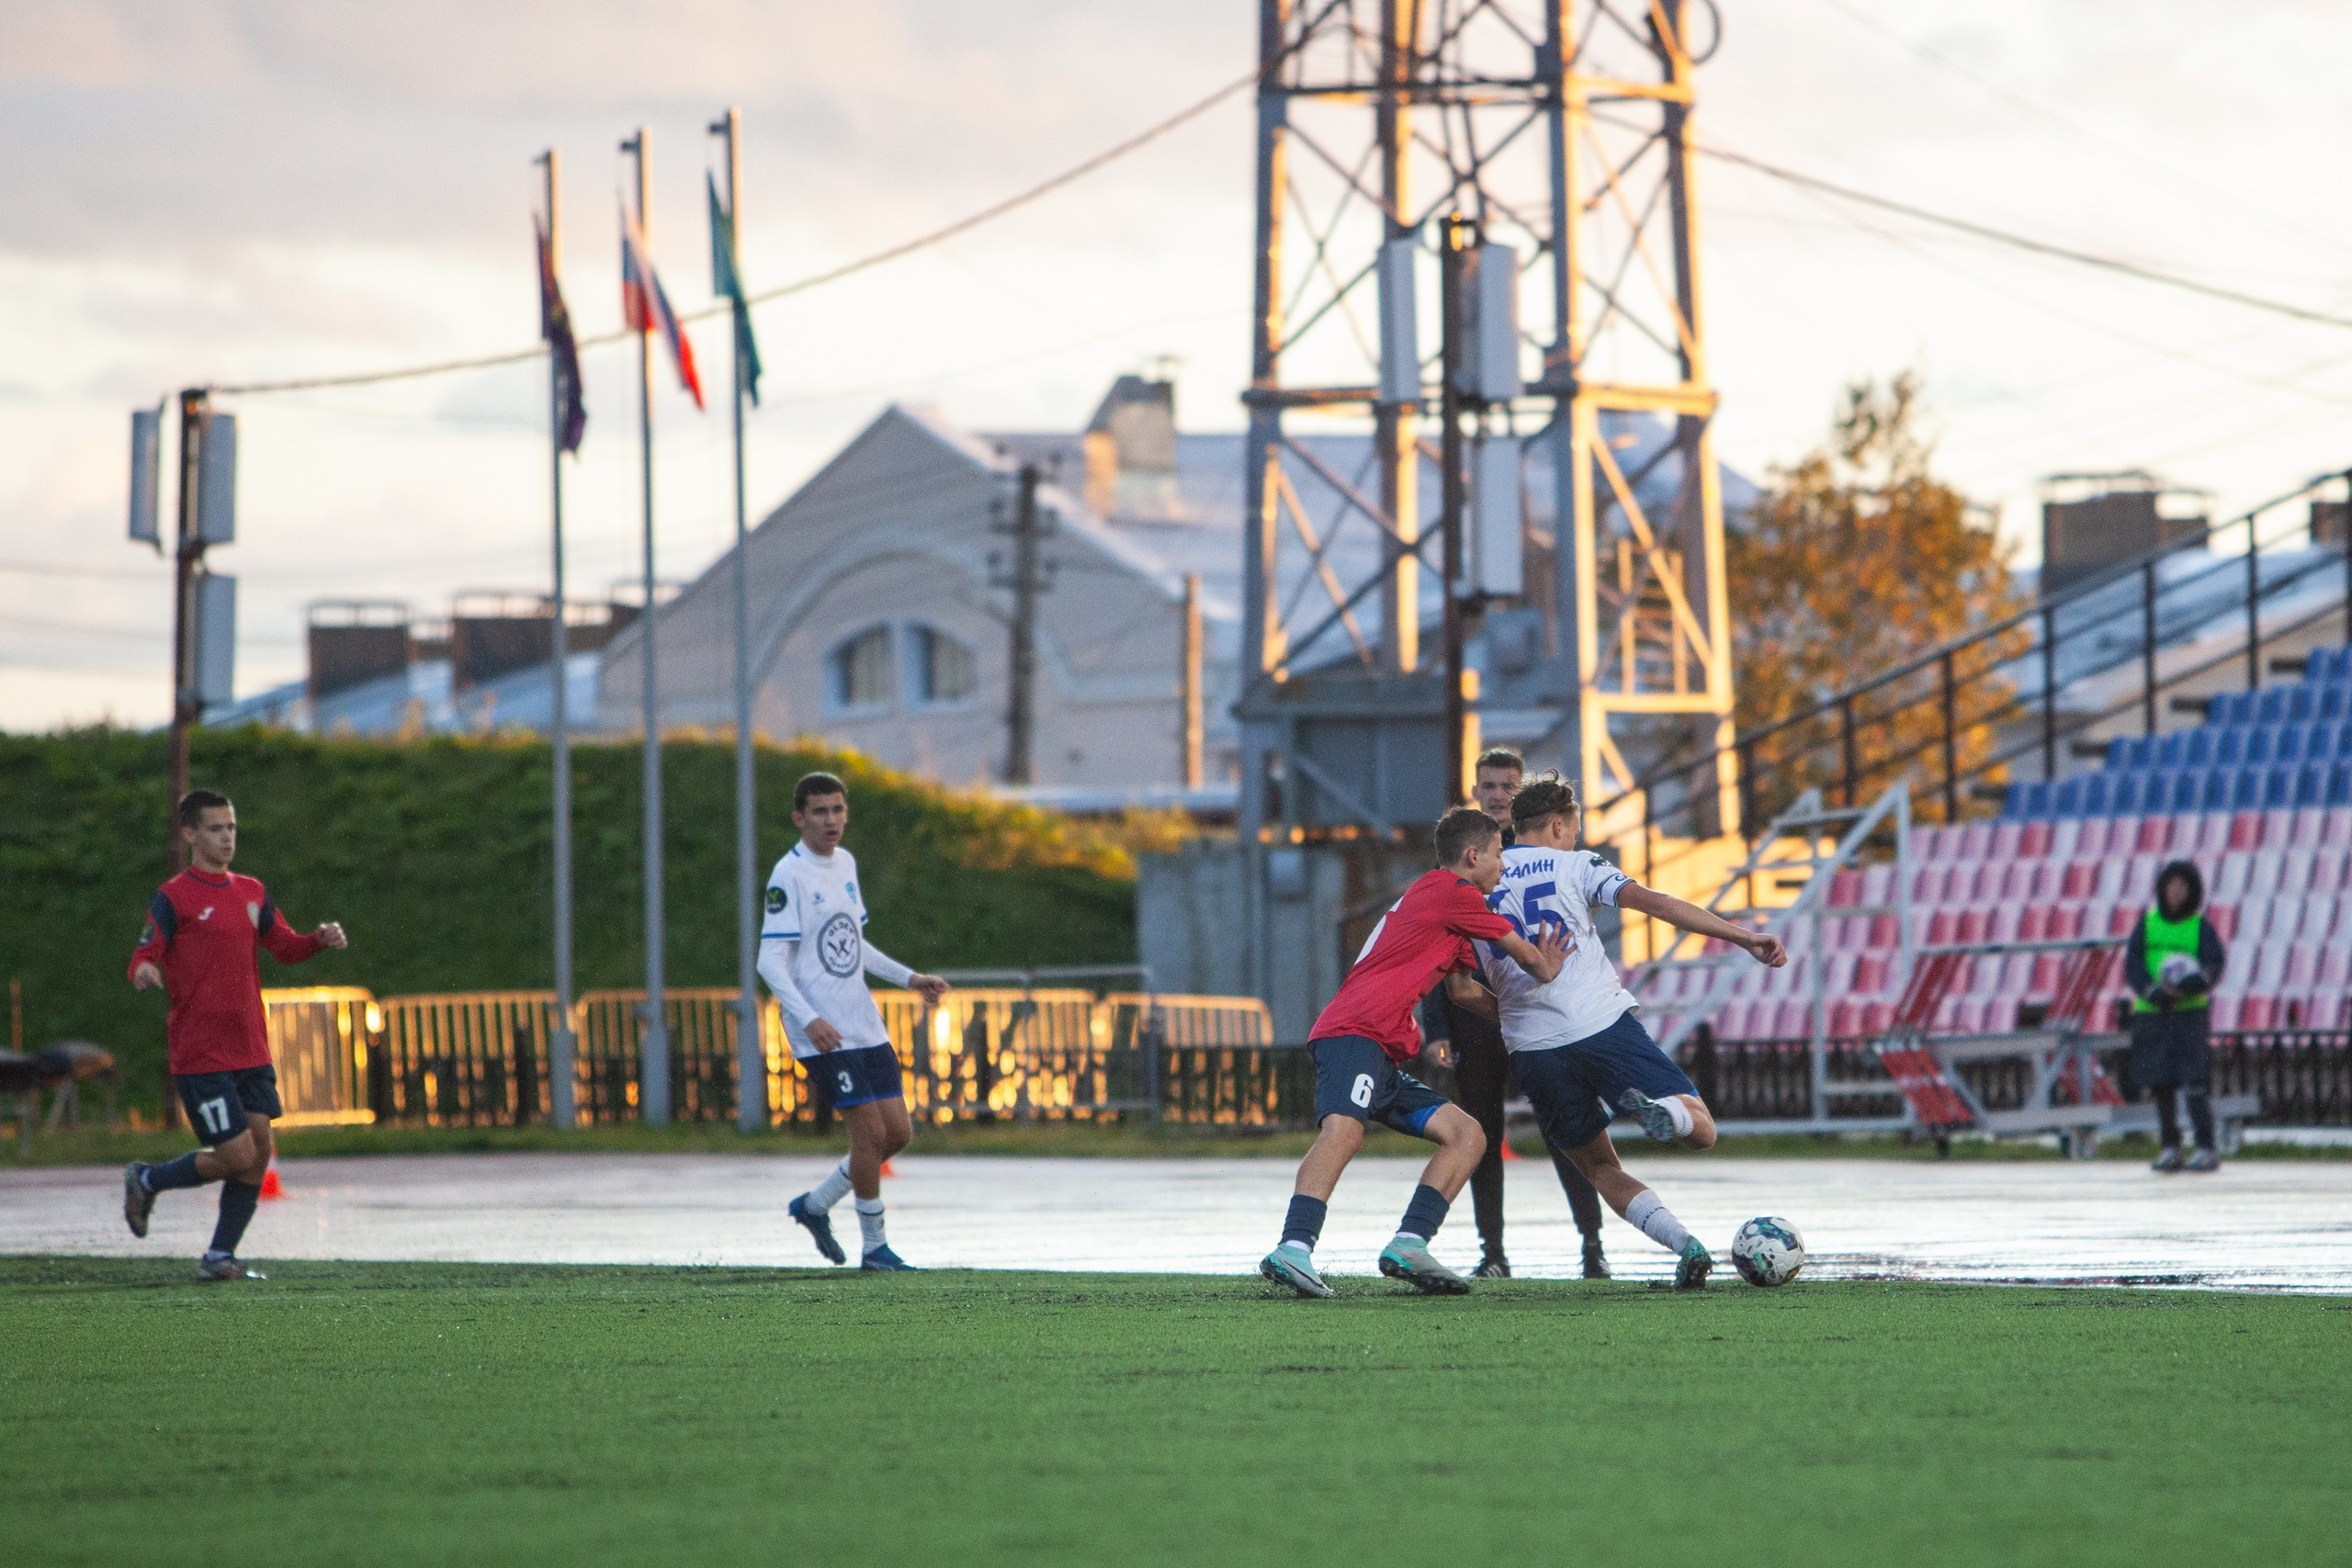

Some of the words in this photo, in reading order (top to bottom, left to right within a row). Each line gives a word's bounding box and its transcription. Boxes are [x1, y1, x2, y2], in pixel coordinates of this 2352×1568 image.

[837, 1071, 853, 1093] 3
[1351, 1073, 1374, 1109] 6
[198, 1097, 231, 1134] 17
